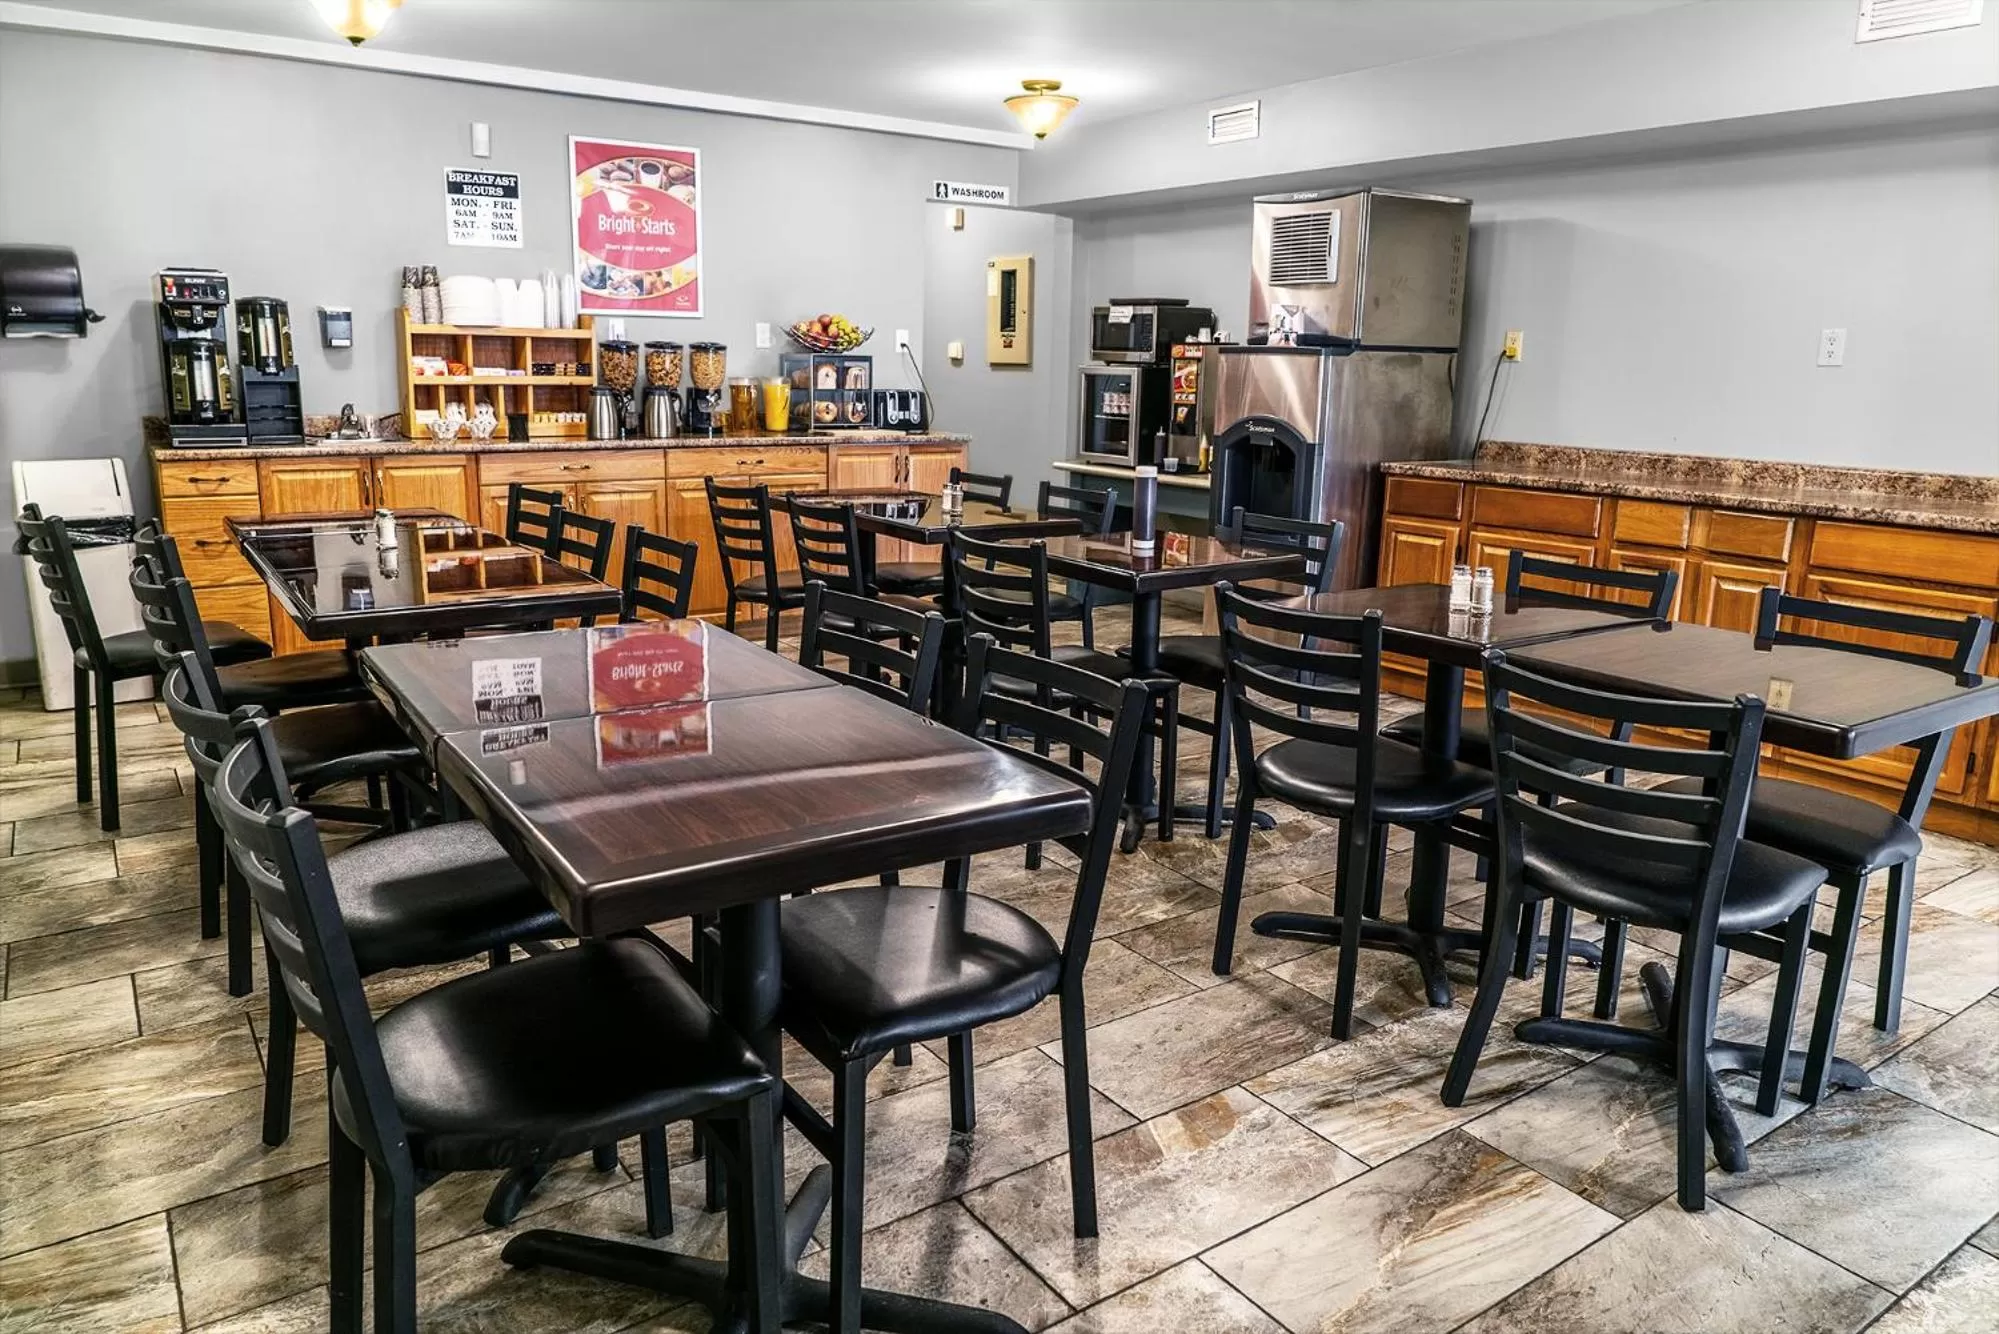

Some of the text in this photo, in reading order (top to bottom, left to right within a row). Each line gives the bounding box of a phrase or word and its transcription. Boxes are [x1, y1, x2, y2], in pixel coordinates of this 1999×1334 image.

[448, 171, 517, 187] BREAKFAST
[462, 184, 504, 196] HOURS
[951, 187, 1005, 200] WASHROOM
[451, 197, 482, 208] MON.
[493, 200, 517, 210] FRI.
[455, 208, 477, 217] 6AM
[453, 219, 480, 229] SAT.
[491, 221, 518, 232] SUN.
[598, 213, 676, 236] Bright Starts
[492, 233, 518, 242] 10AM
